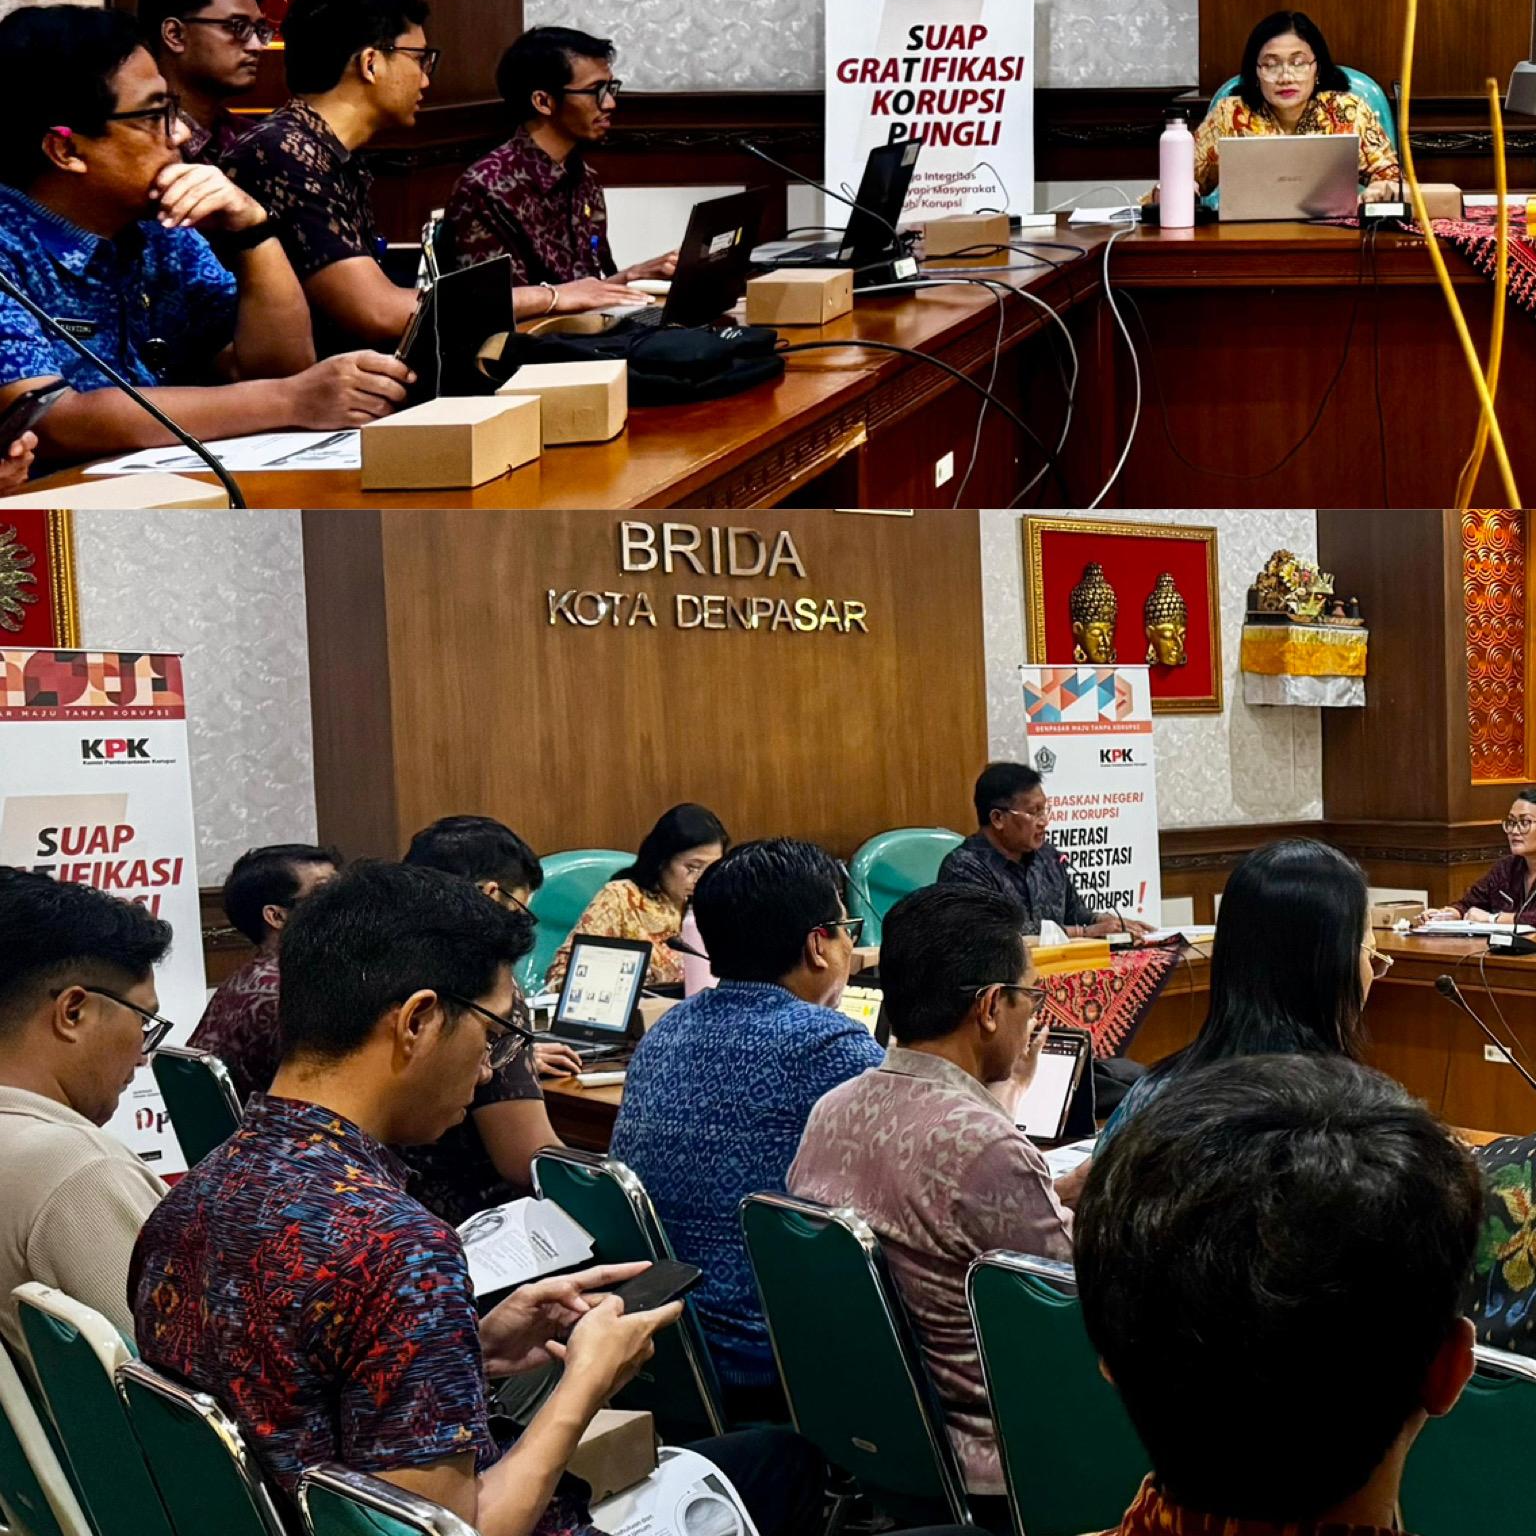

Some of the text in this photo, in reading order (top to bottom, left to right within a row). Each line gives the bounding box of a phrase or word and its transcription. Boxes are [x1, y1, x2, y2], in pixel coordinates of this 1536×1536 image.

[906, 24, 988, 51] SUAP
[836, 56, 1025, 84] GRATIFIKASI
[870, 88, 1006, 116] KORUPSI
[888, 121, 1002, 147] PUNGLI
[921, 199, 962, 209] Korupsi
[620, 521, 806, 577] BRIDA
[548, 589, 869, 633] KOTA DENPASAR
[113, 709, 169, 717] KORUPSI
[81, 738, 150, 759] KPK
[1100, 748, 1133, 763] KPK
[1047, 792, 1144, 807] EBASKAN NEGERI
[1049, 807, 1119, 821] ARI KORUPSI
[37, 824, 135, 857] SUAP
[1068, 846, 1132, 867] PRESTASI
[1072, 870, 1111, 890] ERASI
